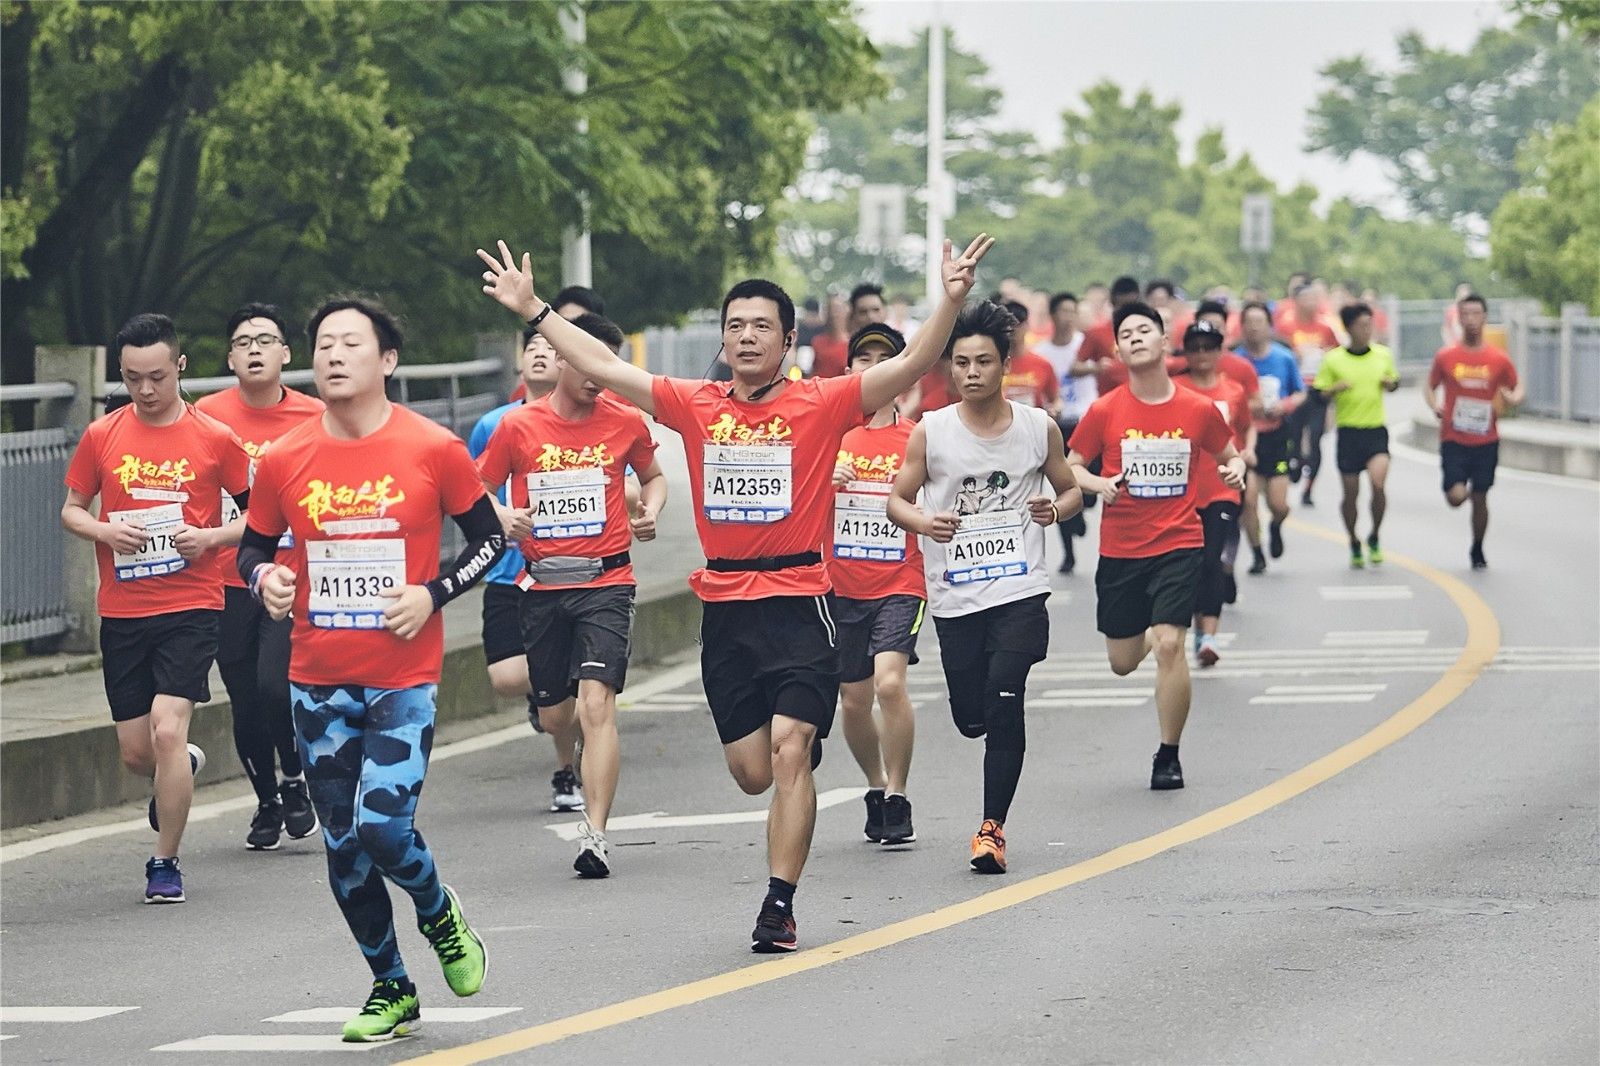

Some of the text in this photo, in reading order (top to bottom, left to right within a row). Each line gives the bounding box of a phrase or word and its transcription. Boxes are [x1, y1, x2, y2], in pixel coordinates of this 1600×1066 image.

[536, 443, 614, 471] 敢为人先
[112, 454, 196, 494] 敢为人先
[1129, 462, 1183, 477] A10355
[713, 476, 781, 496] A12359
[298, 474, 405, 530] 敢为人先
[537, 496, 597, 517] A12561
[841, 519, 898, 538] A11342
[954, 538, 1016, 561] A10024
[319, 576, 394, 598] A11339
